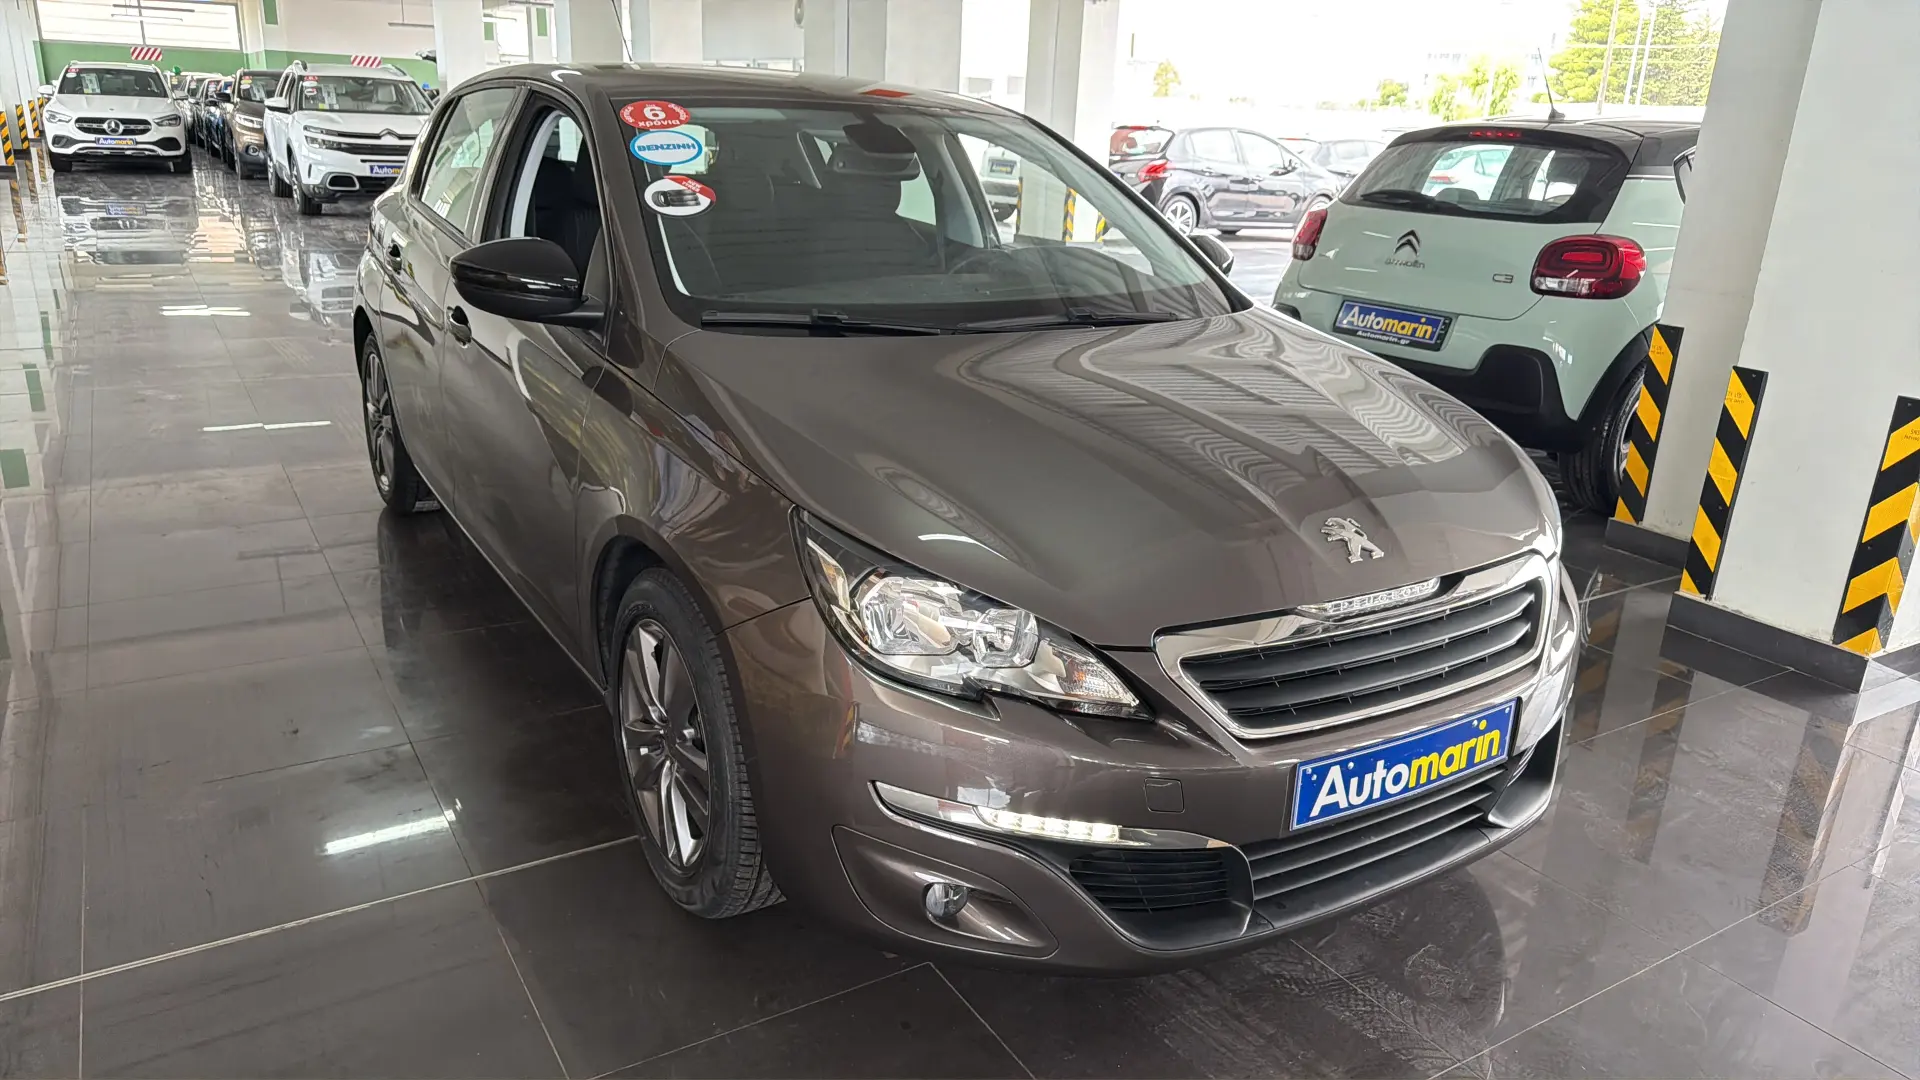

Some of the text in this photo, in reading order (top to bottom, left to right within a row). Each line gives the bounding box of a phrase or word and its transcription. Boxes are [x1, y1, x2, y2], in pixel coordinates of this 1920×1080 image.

[643, 106, 666, 120] 6
[638, 119, 680, 127] χρόνια
[1492, 273, 1514, 284] C3
[1342, 306, 1433, 340] Automarin
[1356, 330, 1411, 345] Automarin.gr
[1309, 720, 1502, 818] Automarin
